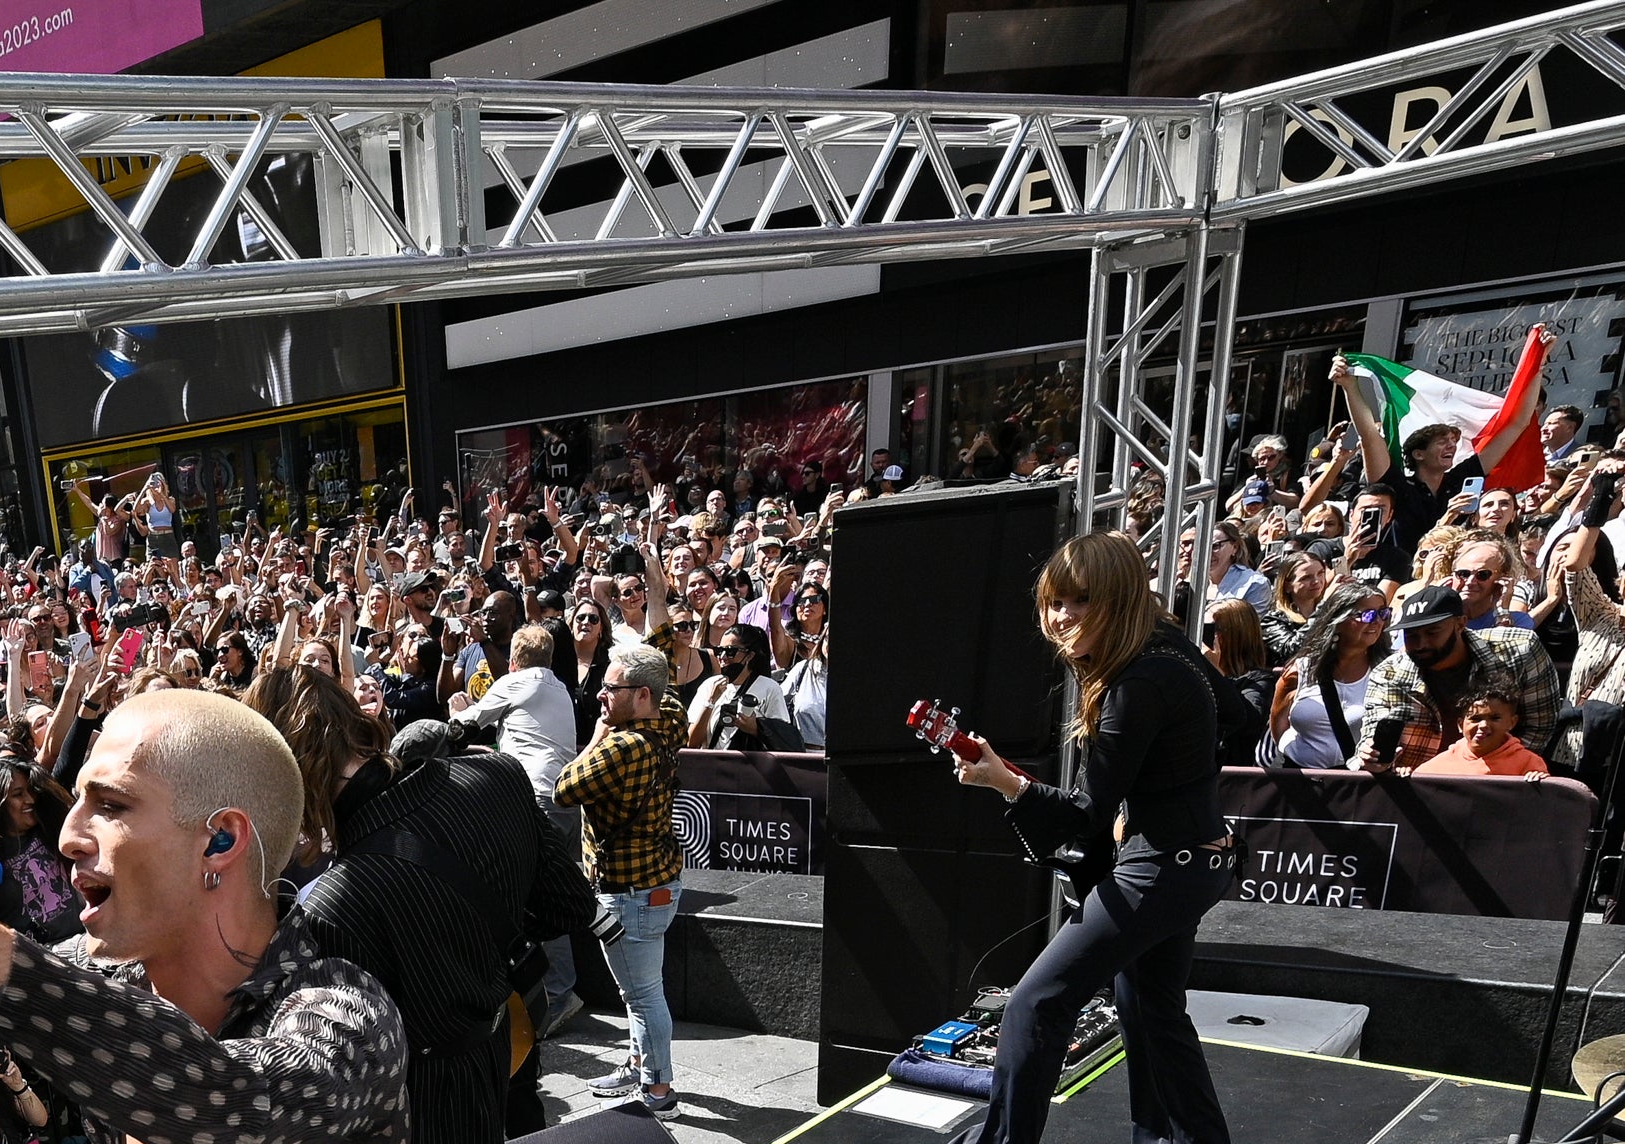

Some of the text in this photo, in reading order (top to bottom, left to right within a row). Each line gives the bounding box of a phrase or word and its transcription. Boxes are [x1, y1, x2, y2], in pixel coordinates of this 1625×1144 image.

[1406, 601, 1428, 616] NY
[726, 819, 791, 840] TIMES
[720, 842, 798, 865] SQUARE
[1257, 851, 1358, 878] TIMES
[1240, 879, 1366, 909] SQUARE
